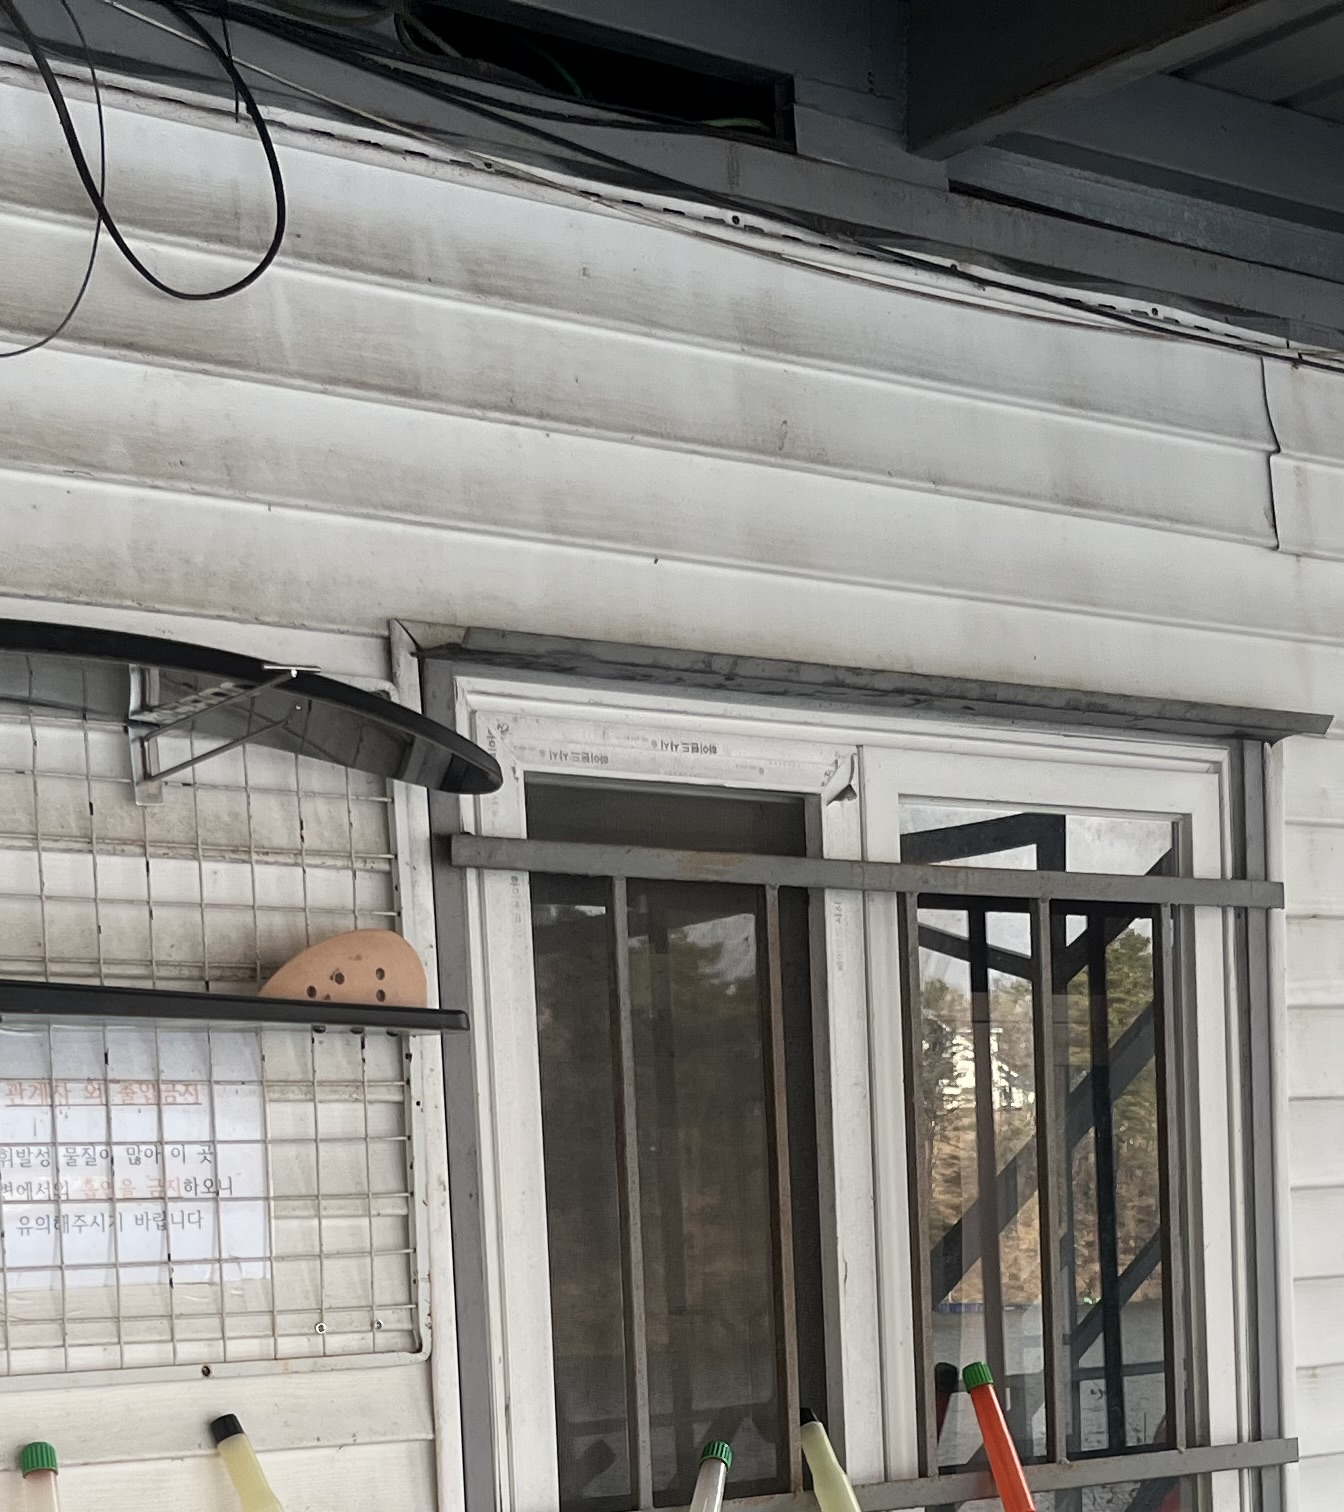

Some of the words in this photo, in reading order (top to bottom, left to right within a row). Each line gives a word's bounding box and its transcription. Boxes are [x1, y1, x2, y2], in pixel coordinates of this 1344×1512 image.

[6, 1082, 70, 1104] 관계자
[84, 1081, 104, 1104] 외
[118, 1082, 199, 1104] 출입금지
[0, 1147, 51, 1168] 휘발성
[63, 1146, 111, 1167] 물질이
[126, 1144, 161, 1165] 많아
[171, 1144, 186, 1164] 이
[197, 1145, 214, 1164] 곳
[16, 1212, 123, 1236] 유의해주시기
[134, 1210, 205, 1231] 바랍니다
